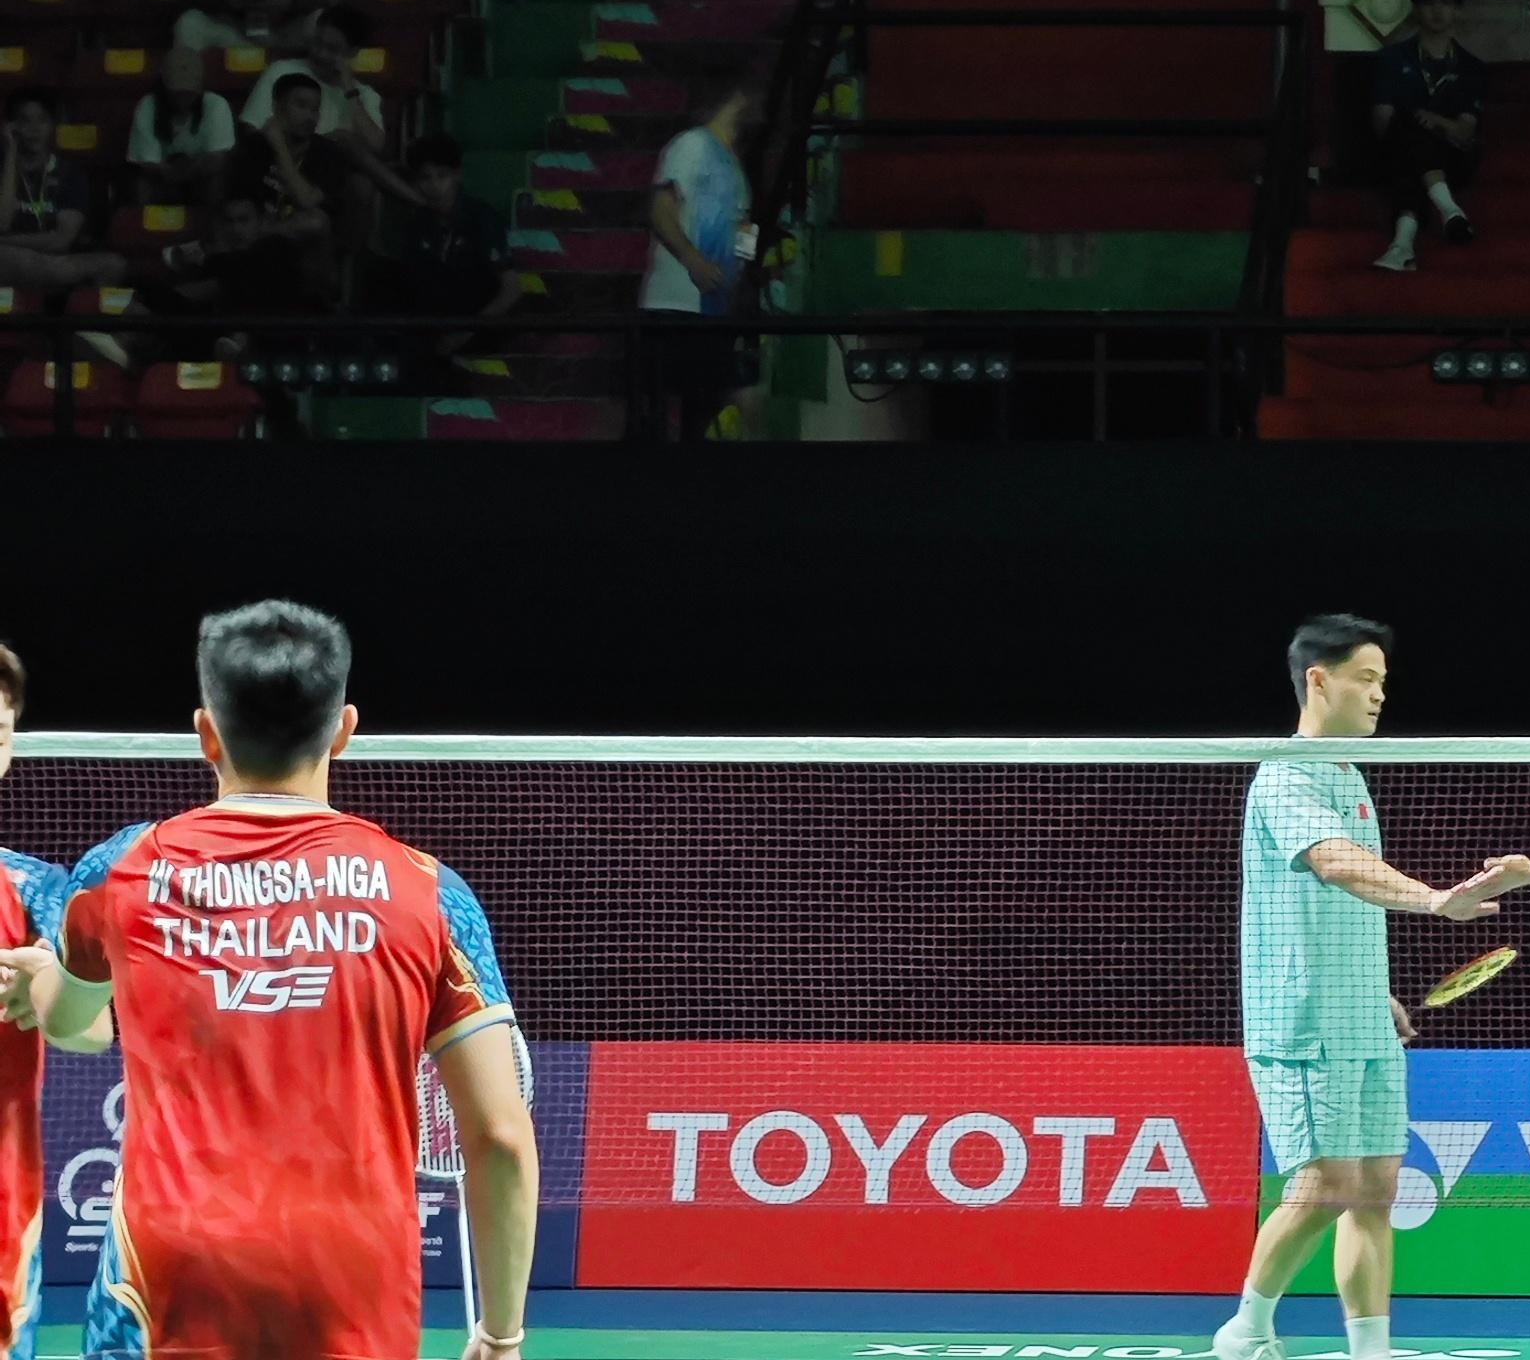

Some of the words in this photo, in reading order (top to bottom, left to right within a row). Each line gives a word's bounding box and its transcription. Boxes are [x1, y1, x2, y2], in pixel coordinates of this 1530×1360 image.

[148, 858, 174, 904] W
[179, 854, 391, 909] THONGSA-NGA
[154, 910, 377, 958] THAILAND
[198, 965, 334, 1013] VSE
[646, 1110, 1210, 1208] TOYOTA
[852, 1343, 1216, 1359] ONEX
